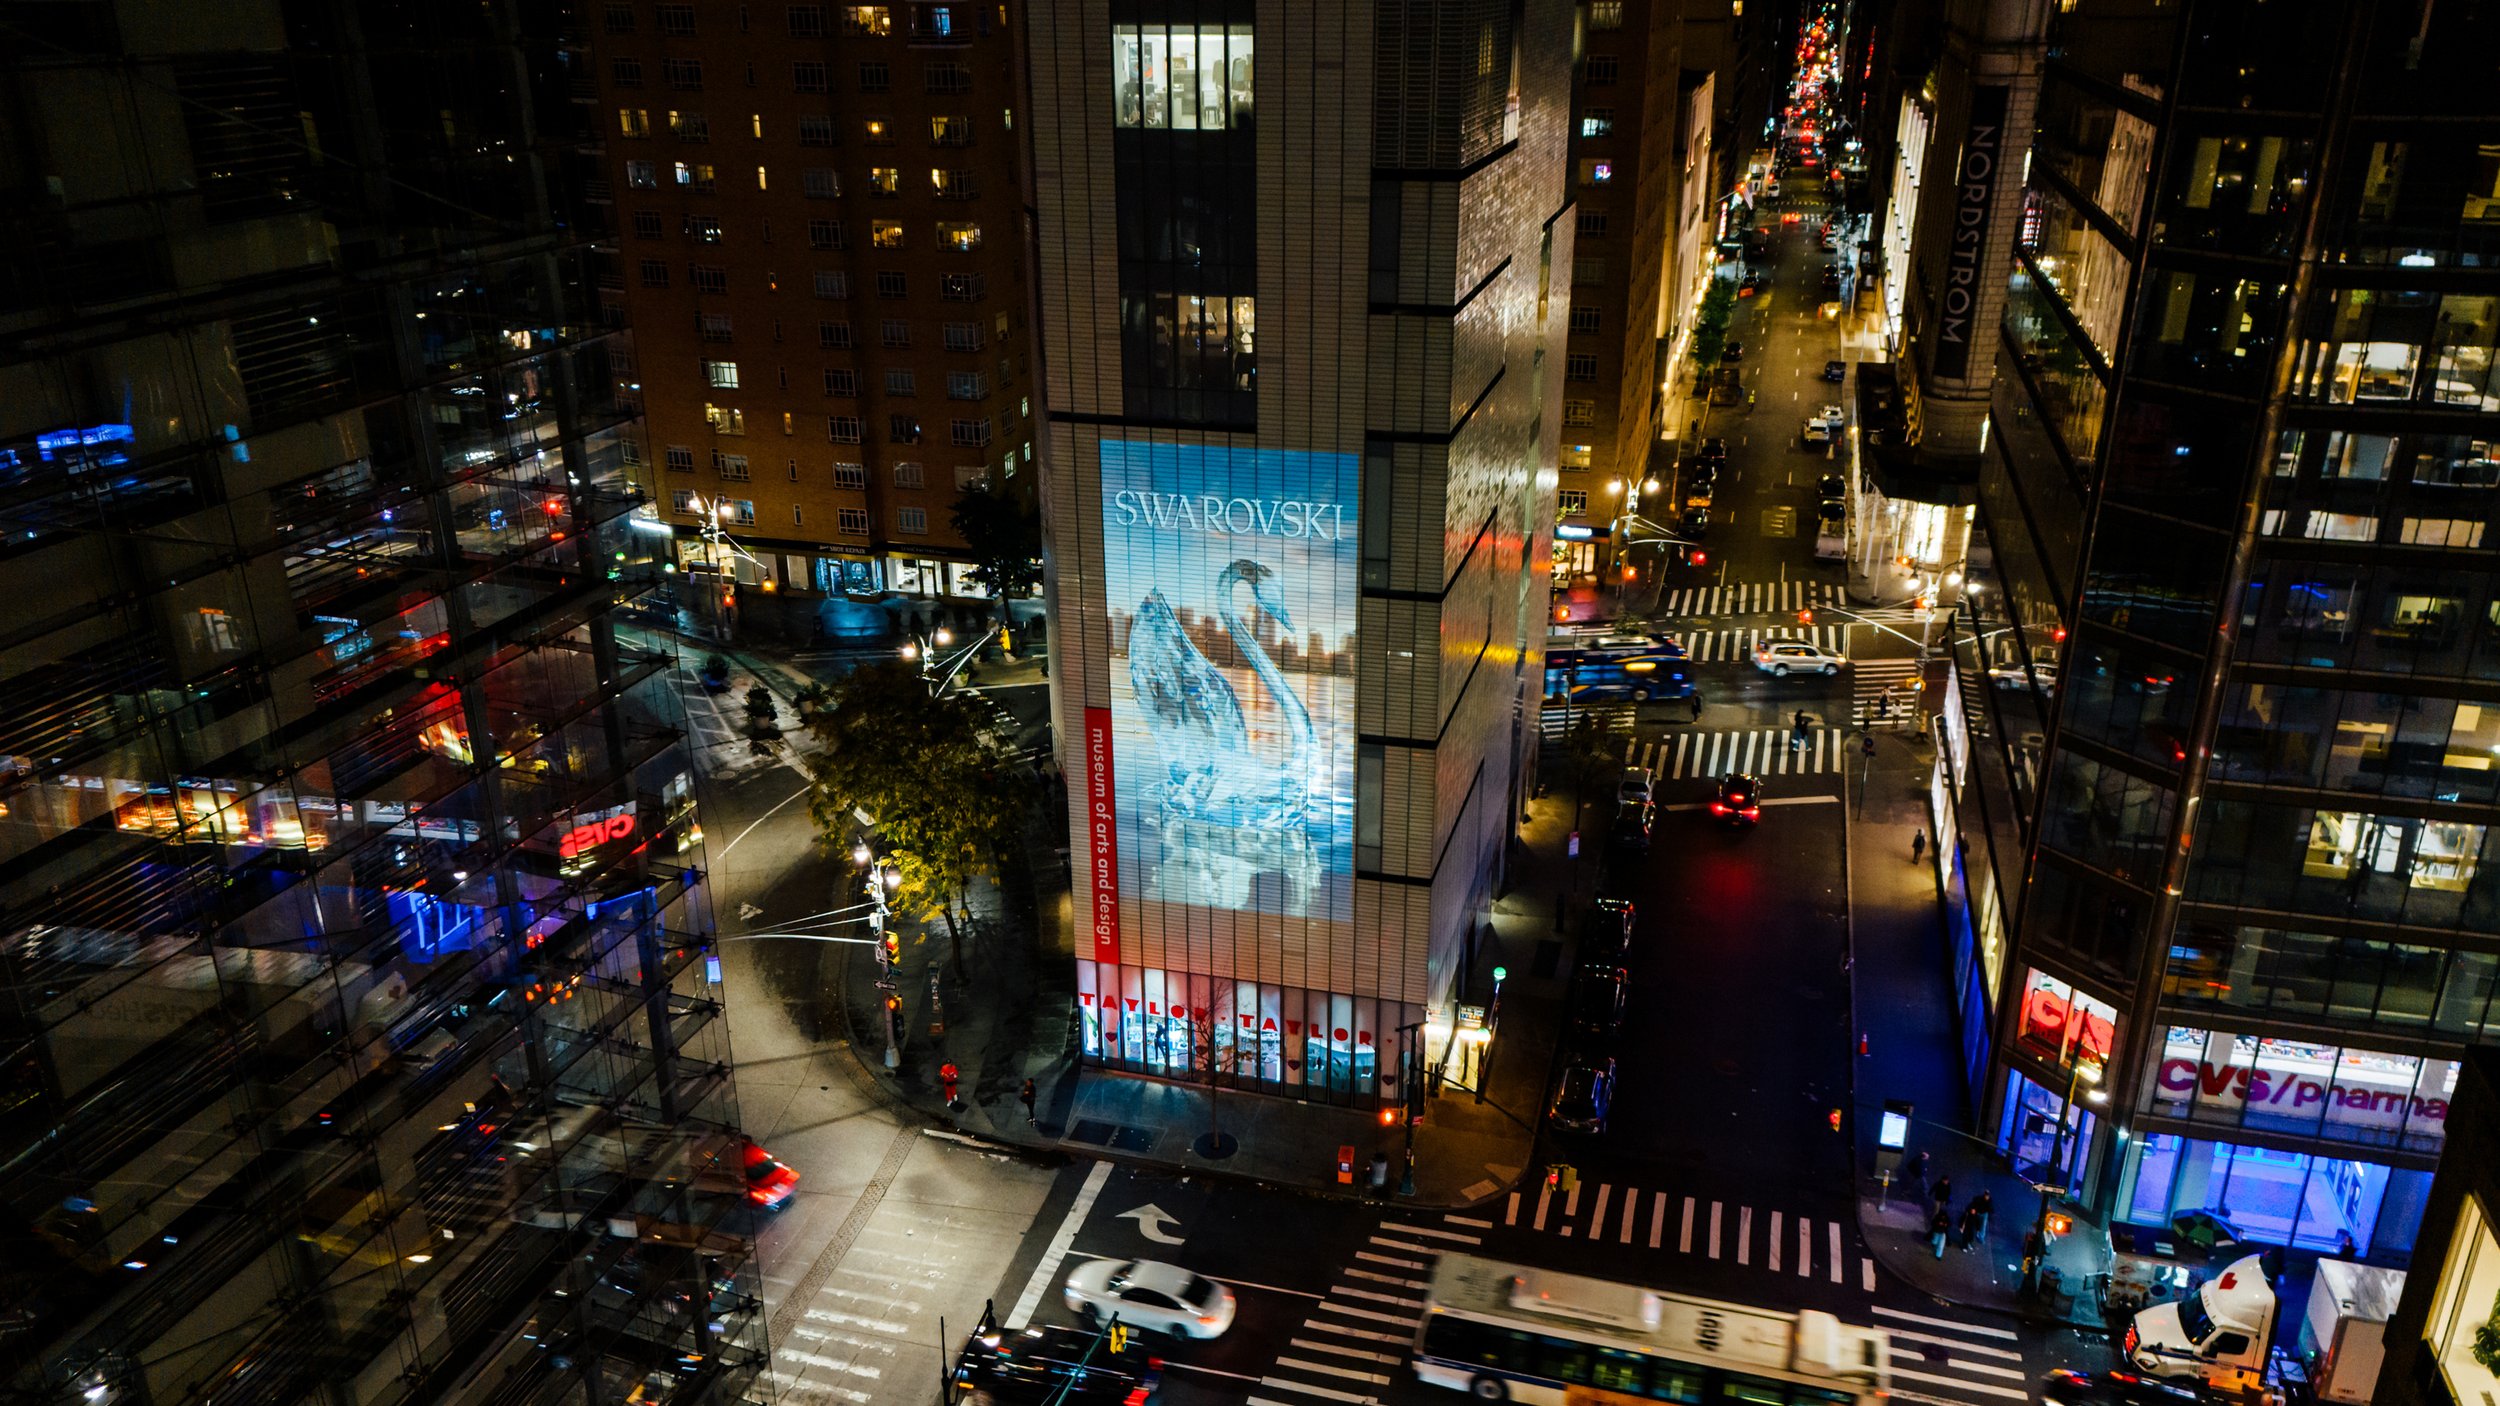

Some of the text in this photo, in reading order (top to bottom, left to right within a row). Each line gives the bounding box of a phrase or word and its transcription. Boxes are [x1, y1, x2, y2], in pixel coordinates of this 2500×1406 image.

[1941, 125, 1996, 343] NORDSTROM
[1114, 489, 1343, 541] SWAROVSKI
[1092, 727, 1115, 946] museum of arts and design
[1080, 992, 1372, 1046] TAYLOR TAYLOR
[2032, 990, 2115, 1054] CVS
